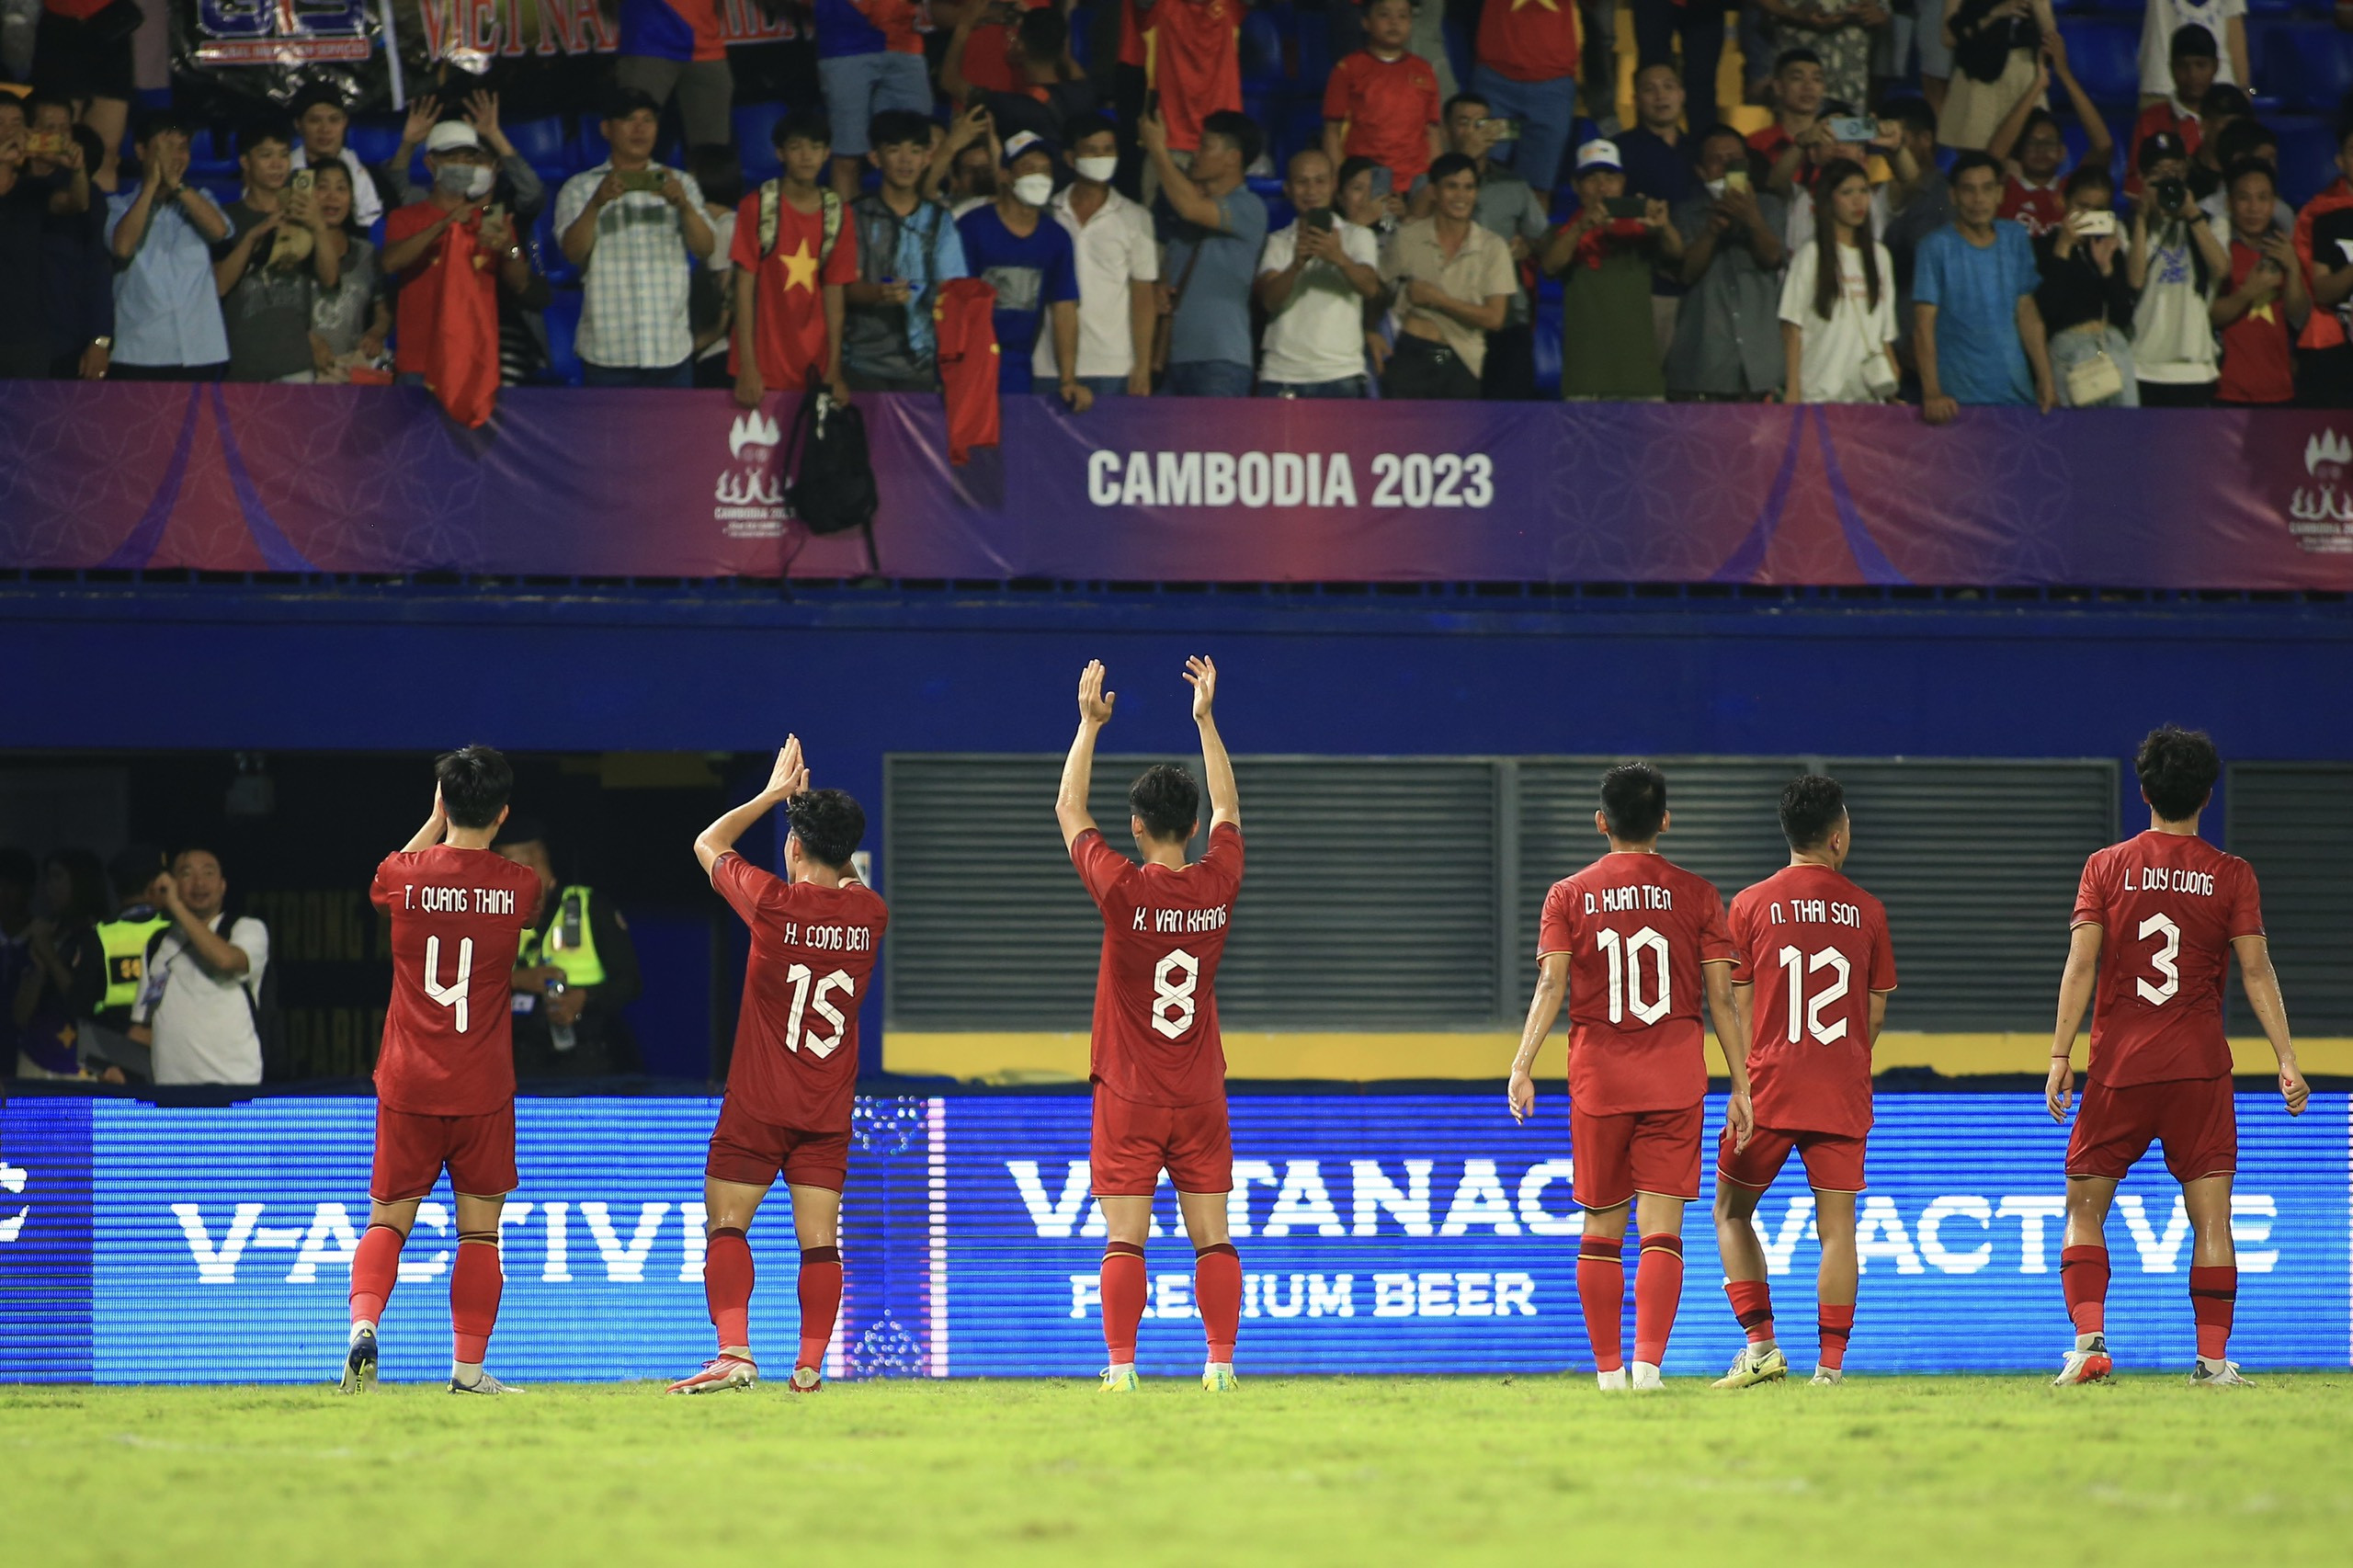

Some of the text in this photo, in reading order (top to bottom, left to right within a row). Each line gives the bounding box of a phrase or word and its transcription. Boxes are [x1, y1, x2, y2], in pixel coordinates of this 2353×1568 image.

[1087, 449, 1494, 507] CAMBODIA 2023
[404, 885, 515, 915] T. QUANG THINH
[1584, 884, 1673, 915] D. XUAN TIEN
[2124, 867, 2215, 896] L. DUY CUONG
[783, 922, 870, 951] H. CONG DEN
[1131, 903, 1227, 933] K. VAN KHANG
[1770, 899, 1860, 928] N. THAI SON
[424, 935, 472, 1034] 4
[1596, 926, 1671, 1026] 10
[2136, 912, 2180, 1006] 3
[785, 963, 855, 1060] 15
[1151, 948, 1199, 1040] 8
[1779, 944, 1851, 1046] 12
[1069, 1273, 1537, 1319] PEIUM BEER
